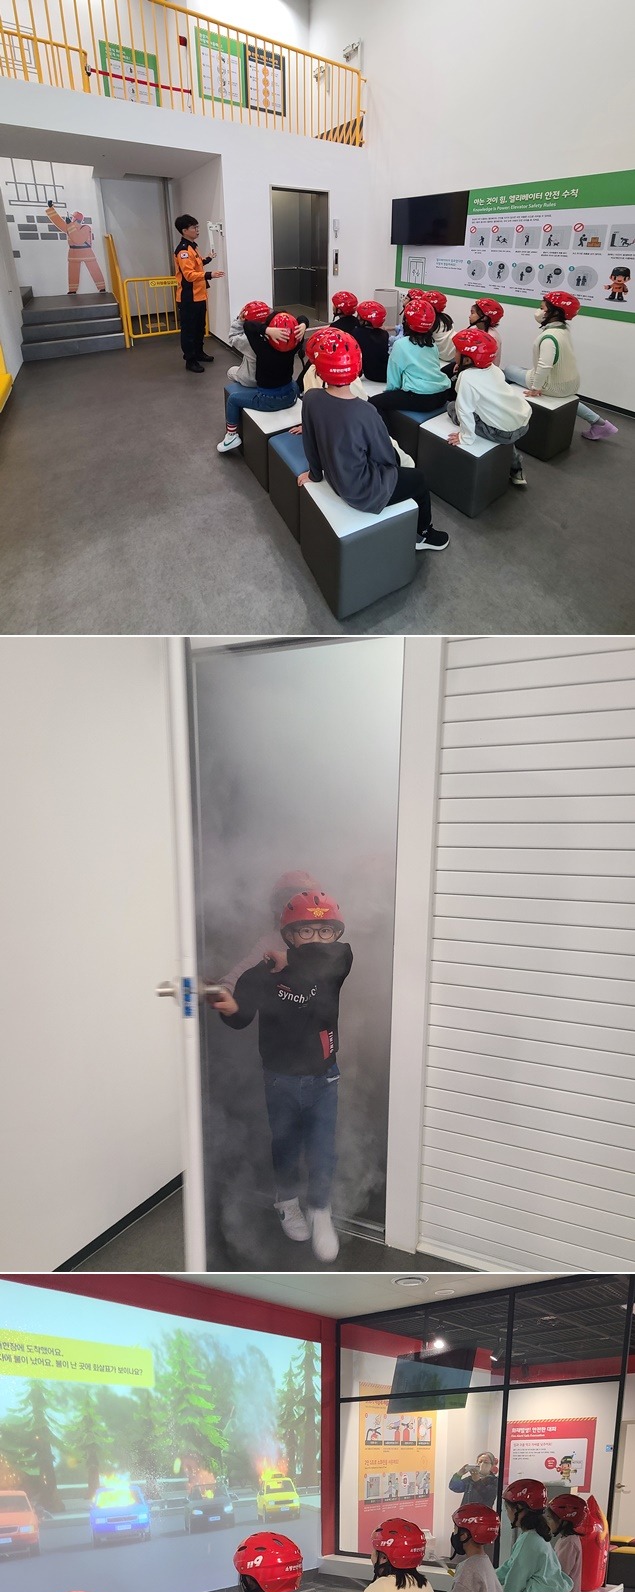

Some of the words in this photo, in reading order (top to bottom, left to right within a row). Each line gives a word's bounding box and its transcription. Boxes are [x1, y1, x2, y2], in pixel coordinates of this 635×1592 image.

[486, 197, 498, 205] 것이
[508, 192, 543, 203] 엘리베이터
[544, 190, 560, 200] 안전
[562, 188, 579, 198] 수칙
[26, 1344, 64, 1357] 도착했어요.
[14, 1355, 28, 1364] 불이
[30, 1357, 54, 1367] 났어요.
[56, 1360, 69, 1368] 불이
[70, 1361, 77, 1369] 난
[79, 1362, 92, 1371] 곳에
[117, 1367, 143, 1376] 보이나요?
[247, 1555, 263, 1569] 119
